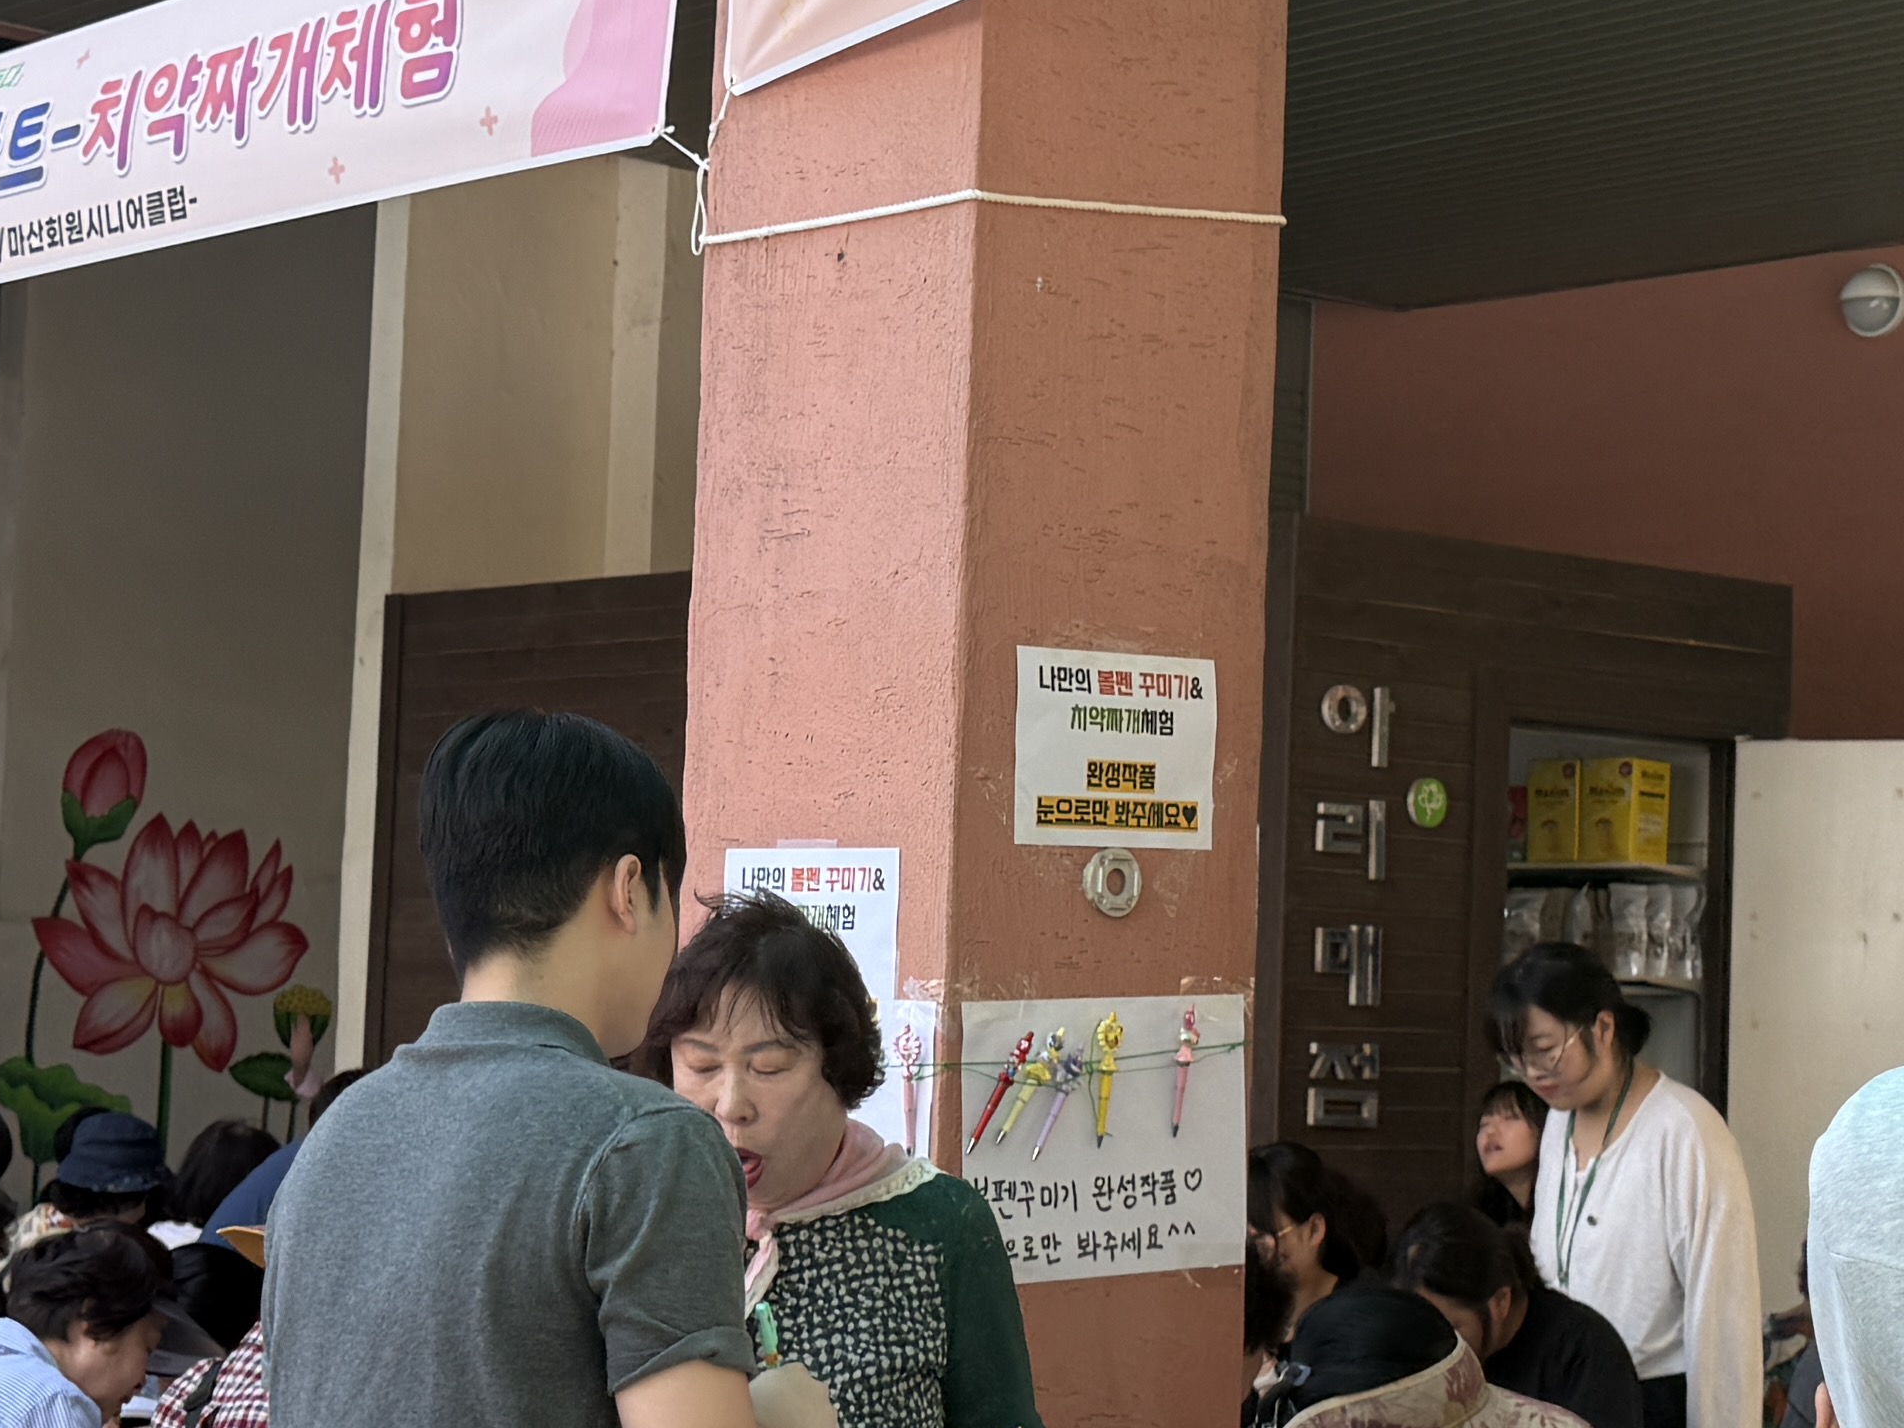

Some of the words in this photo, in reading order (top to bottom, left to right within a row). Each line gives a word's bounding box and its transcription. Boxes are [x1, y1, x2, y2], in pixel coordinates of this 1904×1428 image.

[1038, 664, 1092, 694] 나만의
[1097, 668, 1134, 697] 볼펜
[1138, 671, 1204, 700] 꾸미기&
[1070, 703, 1174, 737] 치약짜개체험
[1086, 759, 1156, 791] 완성작품
[1036, 796, 1111, 825] 눈으로만
[741, 866, 786, 893] 나만의
[825, 866, 886, 893] 꾸미기&
[1092, 1169, 1178, 1212] 완성작품
[1006, 1231, 1062, 1266] 으로만
